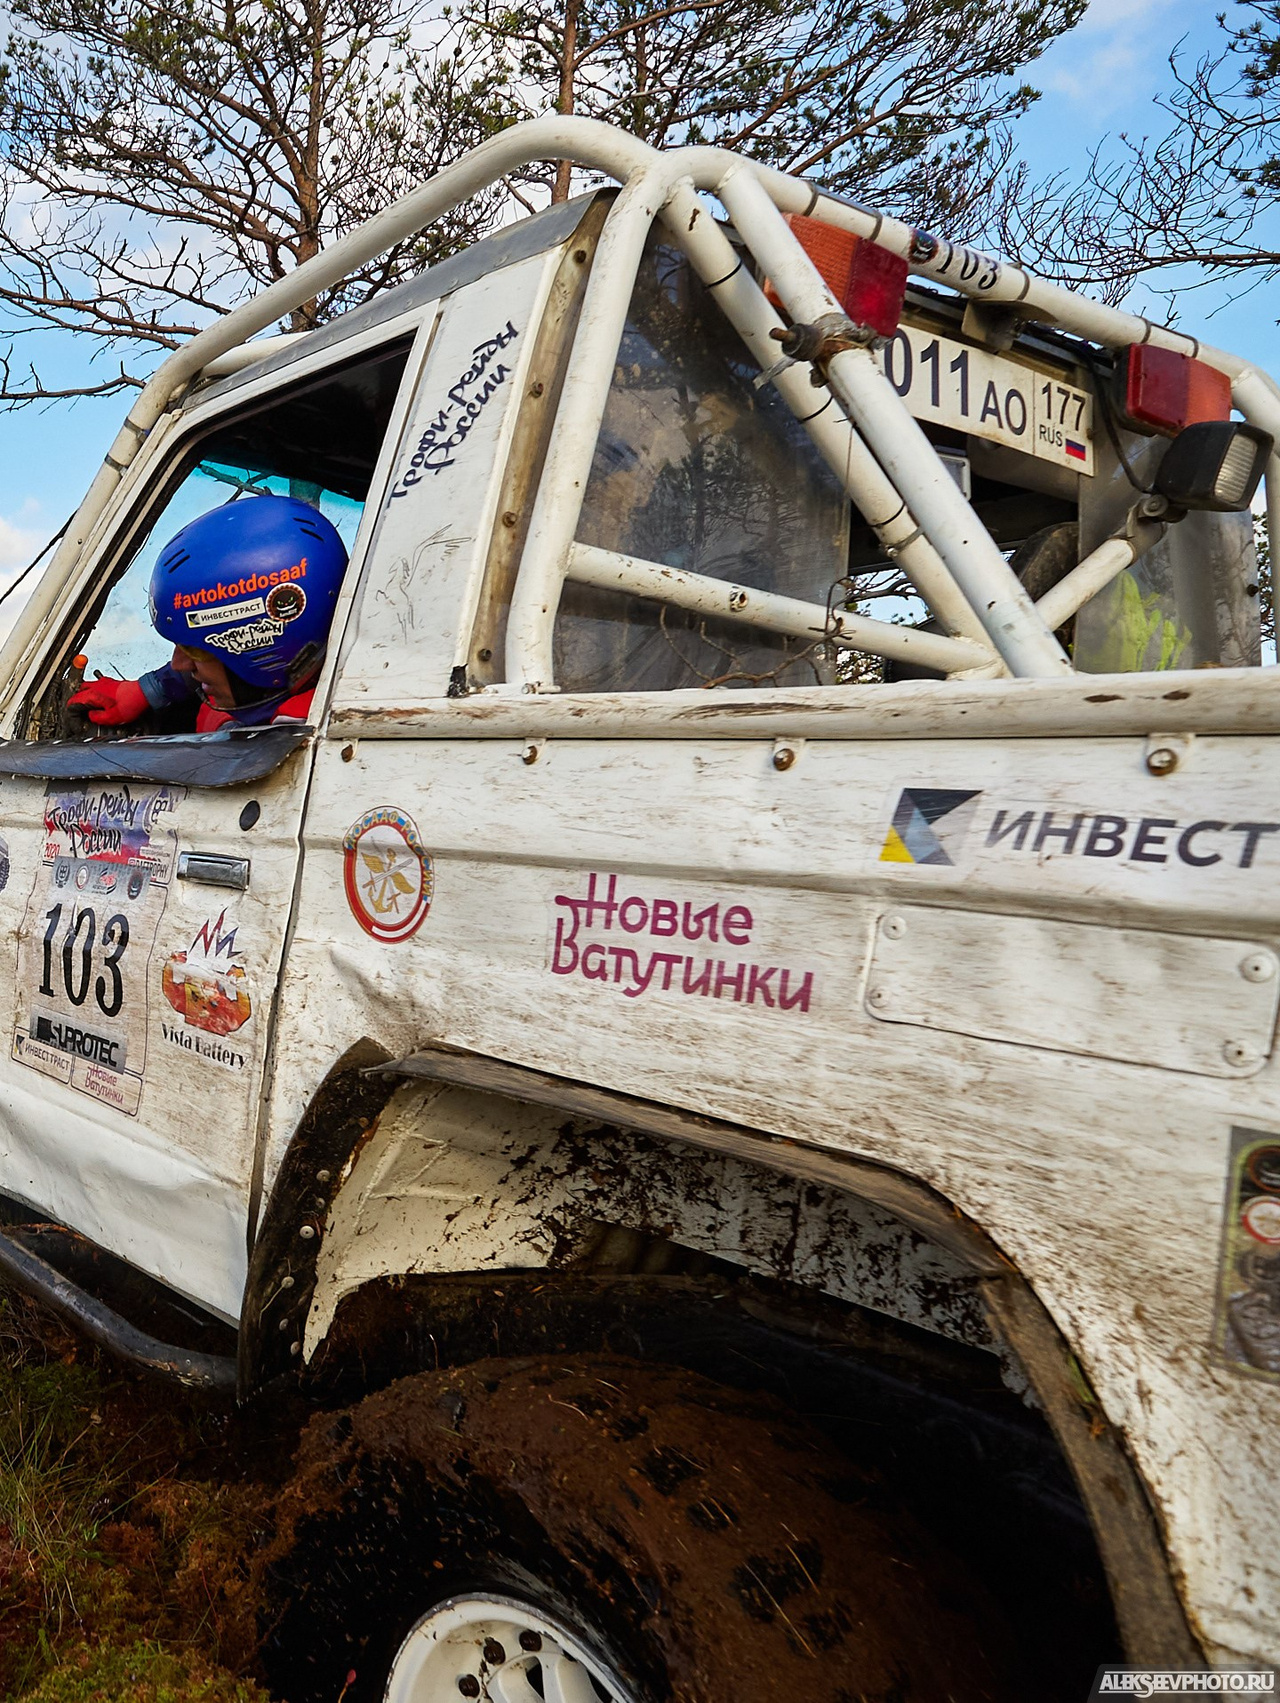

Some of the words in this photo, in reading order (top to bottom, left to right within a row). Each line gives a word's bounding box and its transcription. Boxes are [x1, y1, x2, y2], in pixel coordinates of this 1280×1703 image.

[936, 243, 998, 290] 103
[424, 363, 511, 475] России
[1041, 381, 1086, 431] 177
[1039, 424, 1063, 447] RUS
[173, 558, 308, 609] #avtokotdosaaf
[200, 603, 261, 622] ИНВЕСТТРАСТ
[228, 636, 273, 653] России
[70, 823, 121, 858] России
[985, 810, 1280, 868] ИНВЕСТ
[554, 873, 753, 945] Новые
[38, 903, 130, 1017] 103
[551, 917, 814, 1012] Ватутинки
[25, 1042, 70, 1071] ИНВЕСТТРАСТ
[49, 1019, 120, 1067] SUPROTEC
[162, 1023, 192, 1050] Vista
[195, 1036, 247, 1070] Battery
[85, 1074, 124, 1104] Ватутинки
[87, 1065, 118, 1086] Новые
